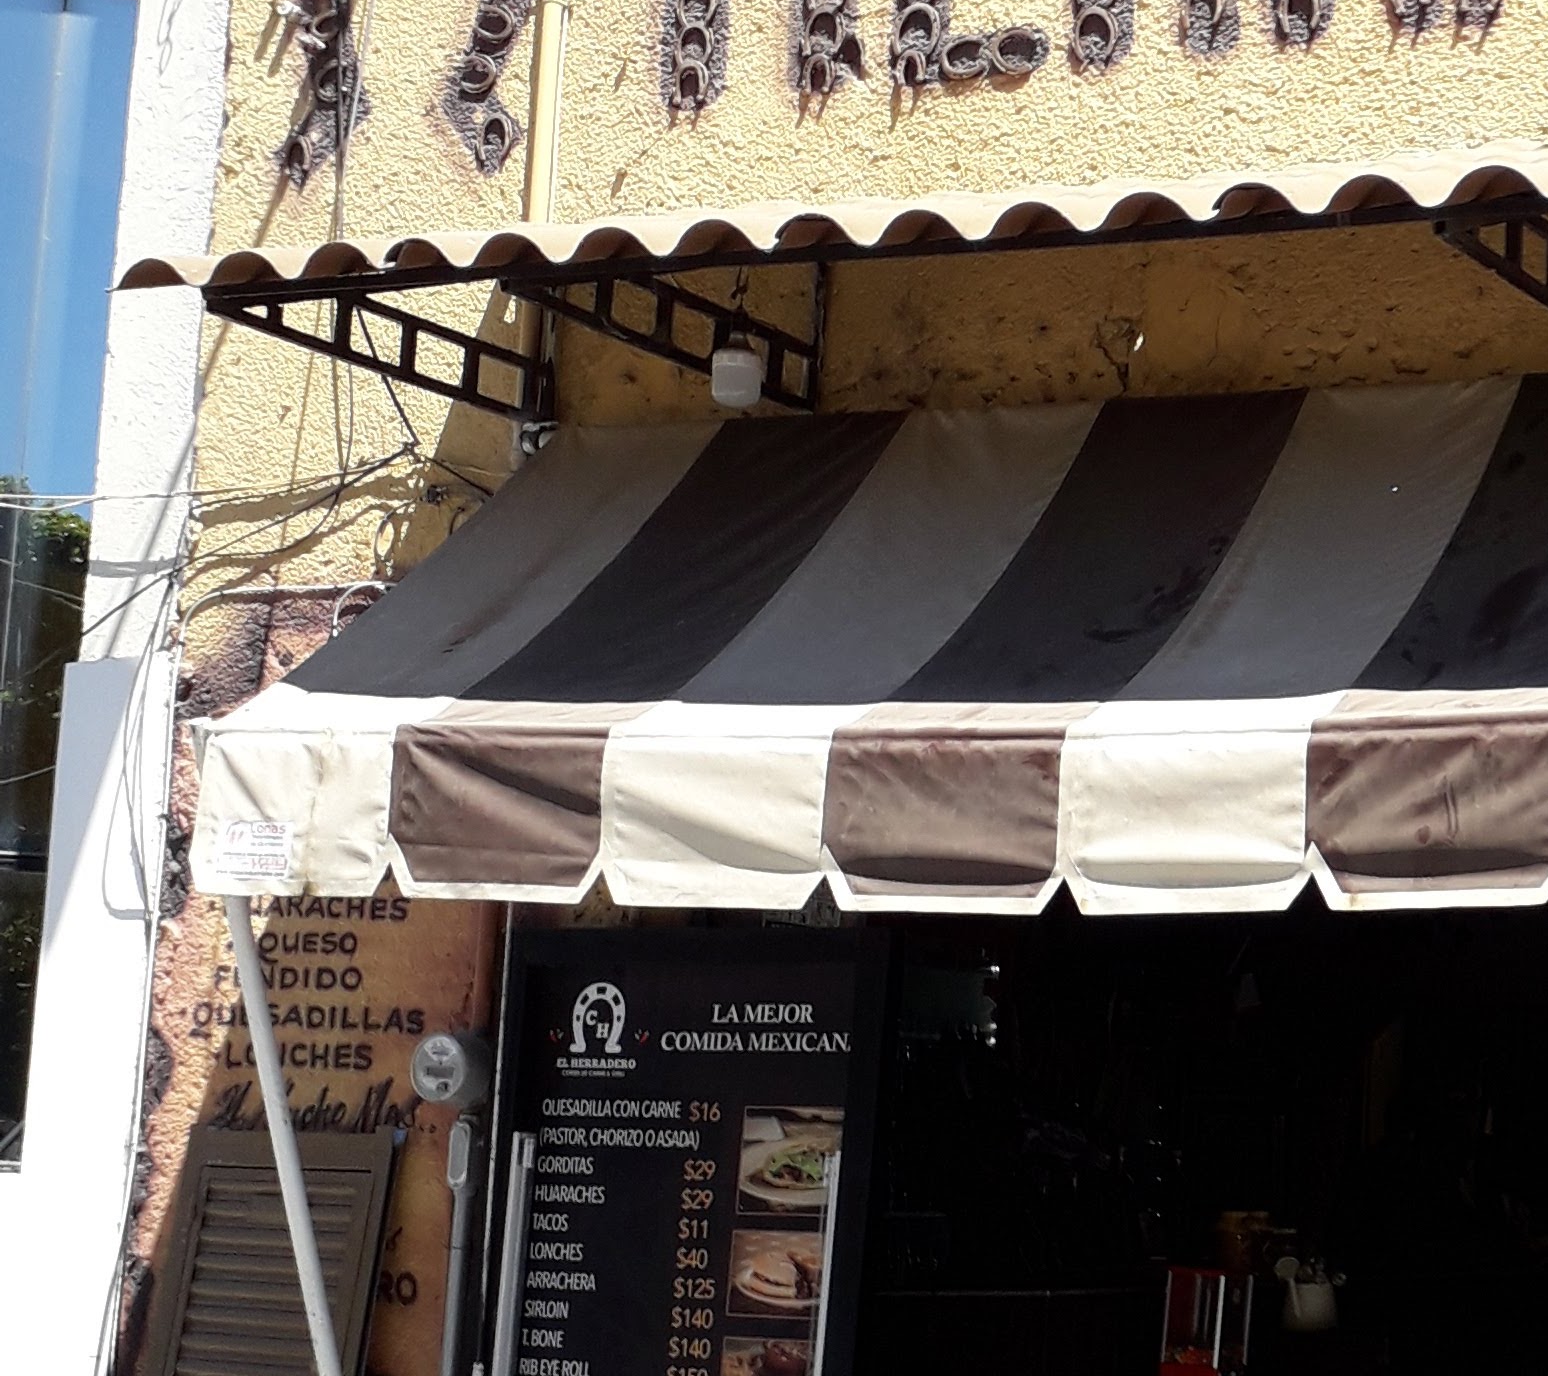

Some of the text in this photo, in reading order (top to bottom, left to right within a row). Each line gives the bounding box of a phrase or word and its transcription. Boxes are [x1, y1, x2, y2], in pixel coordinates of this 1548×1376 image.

[258, 931, 358, 963] QUESO
[712, 1003, 814, 1024] LA MEJOR
[660, 1031, 743, 1053] COMIDA
[542, 1098, 721, 1122] QUESADILLA CON CARNE $16
[589, 1128, 644, 1148] CHORIZO
[537, 1156, 716, 1181] GORDITAS $29
[534, 1184, 714, 1210] HUARACHES $29
[532, 1213, 709, 1240] TACOS $11
[529, 1242, 709, 1270] LONCHES $40
[526, 1271, 716, 1299] ARRACHERA $125
[524, 1300, 714, 1330] SIRLOIN $140
[531, 1330, 565, 1349] BONE
[668, 1336, 712, 1360] $140
[519, 1358, 539, 1376] RIB
